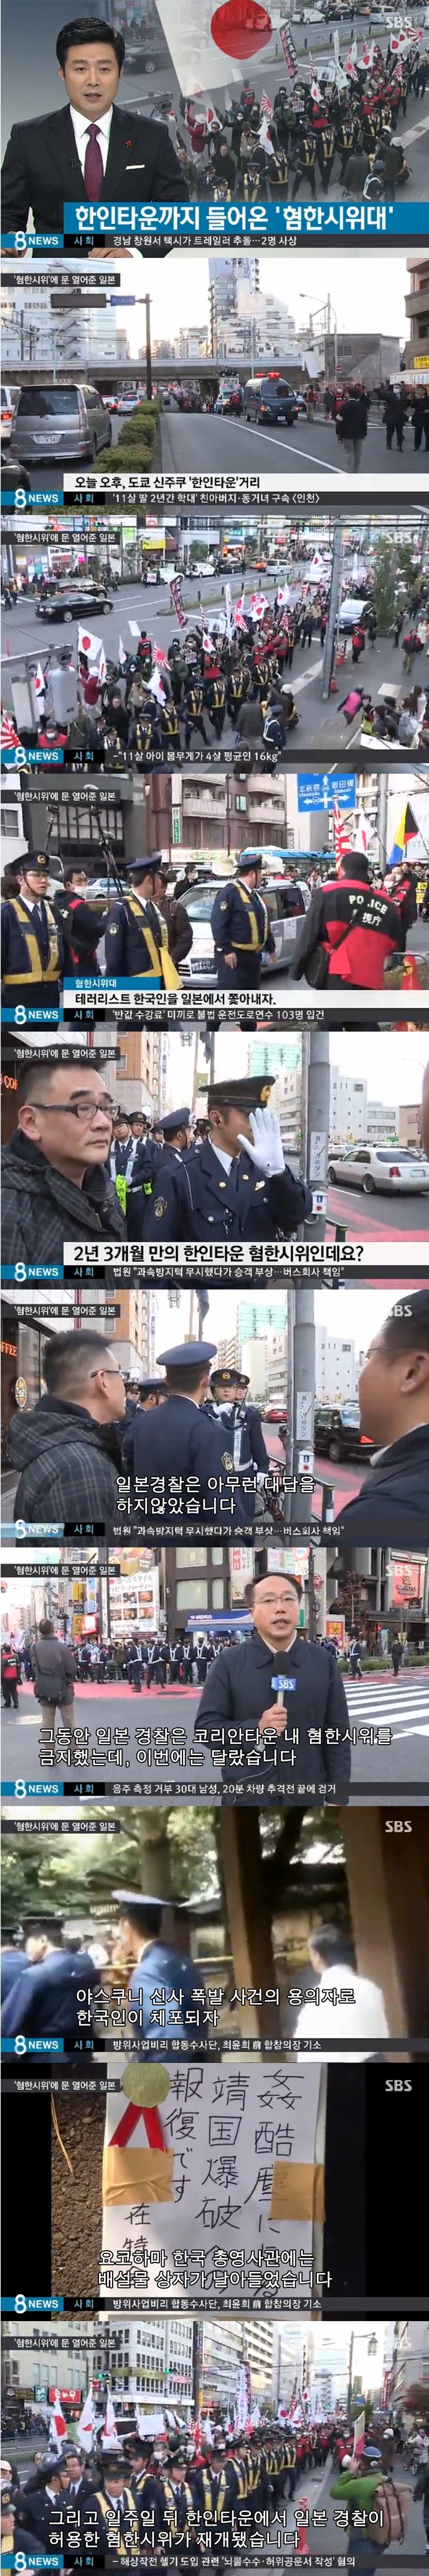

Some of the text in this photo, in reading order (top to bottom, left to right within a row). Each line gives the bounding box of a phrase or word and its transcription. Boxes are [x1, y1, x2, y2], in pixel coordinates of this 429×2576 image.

[299, 783, 320, 793] 北新宿
[332, 779, 354, 789] 飯田橋
[349, 895, 388, 914] POICE
[352, 909, 382, 926] 視庁
[278, 1680, 293, 1688] SBS
[164, 2067, 204, 2203] 報復です
